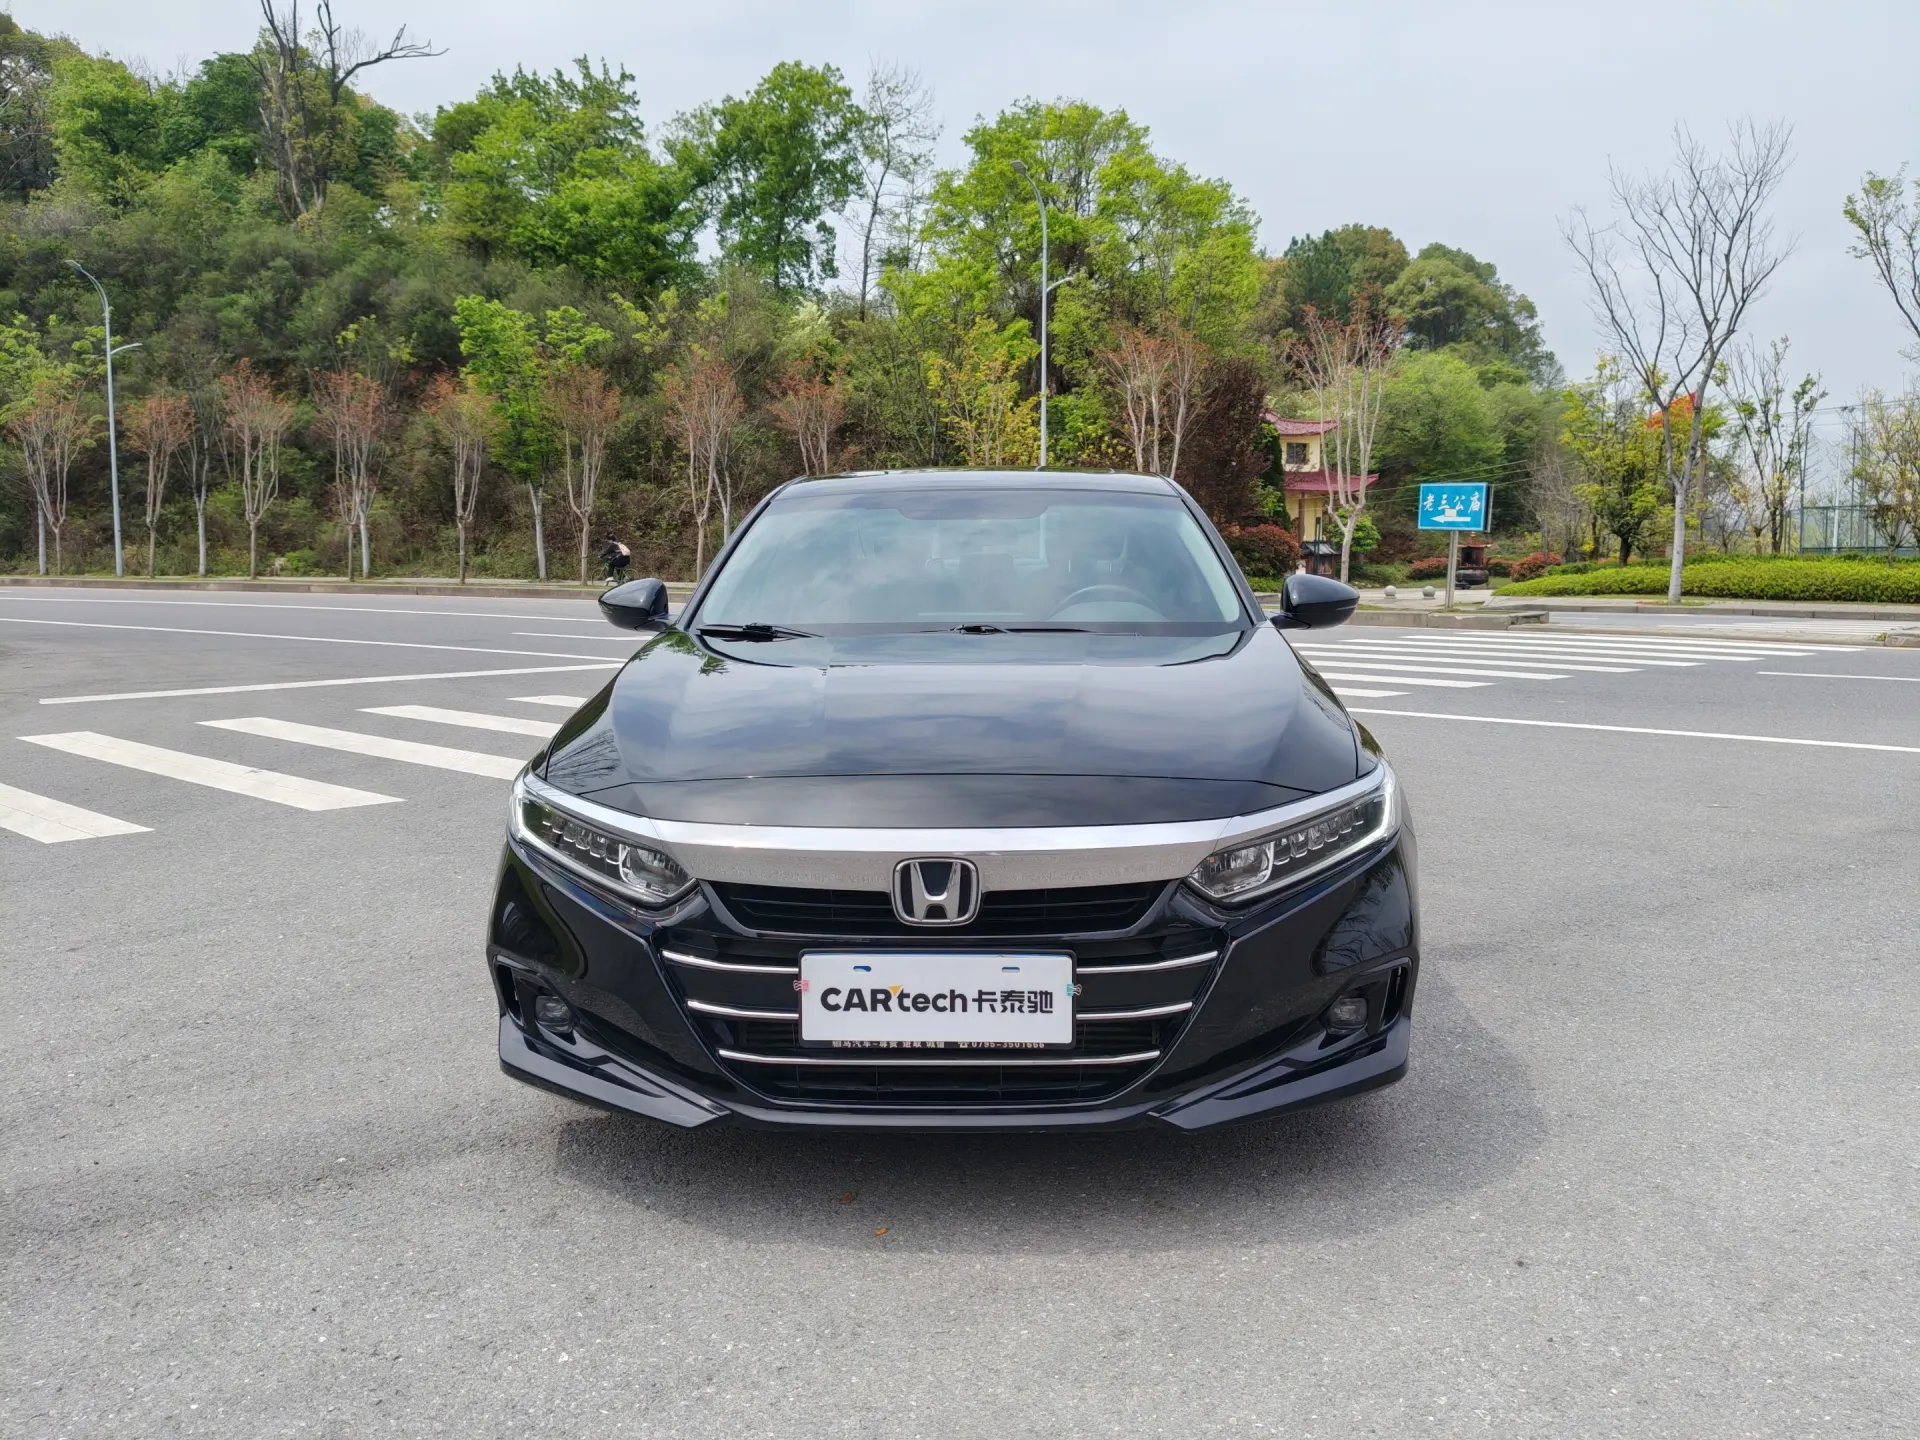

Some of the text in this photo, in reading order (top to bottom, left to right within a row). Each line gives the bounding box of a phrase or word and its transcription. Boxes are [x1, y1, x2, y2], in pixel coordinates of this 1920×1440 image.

[1423, 491, 1481, 514] 老三公庙
[972, 989, 1054, 1014] 卡泰驰
